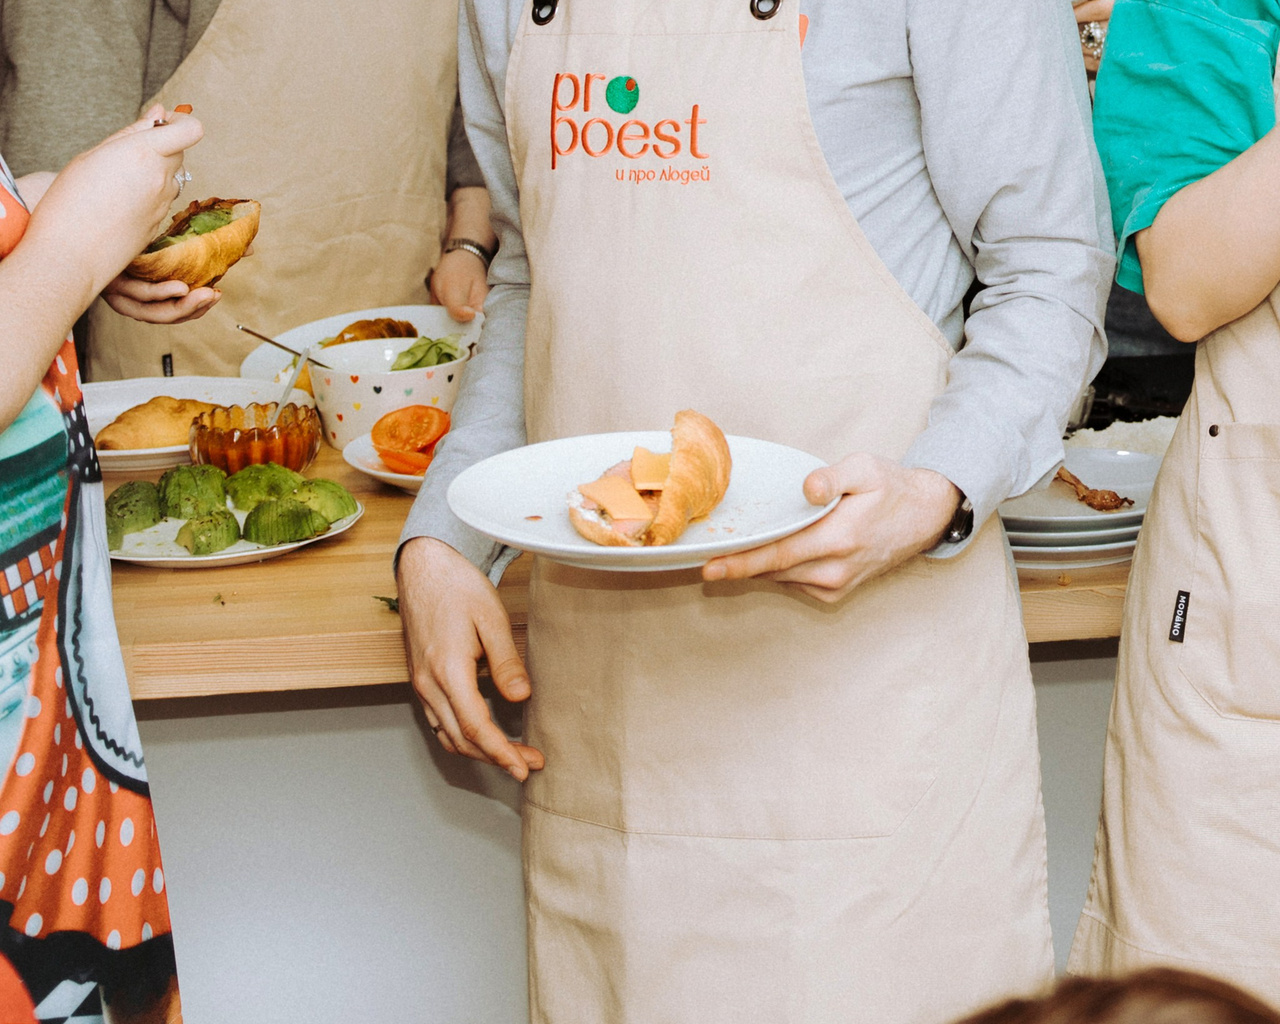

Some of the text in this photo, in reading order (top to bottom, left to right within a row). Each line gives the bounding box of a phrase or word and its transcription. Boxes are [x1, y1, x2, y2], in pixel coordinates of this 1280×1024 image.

[551, 104, 710, 170] poest
[615, 165, 711, 185] и про людей
